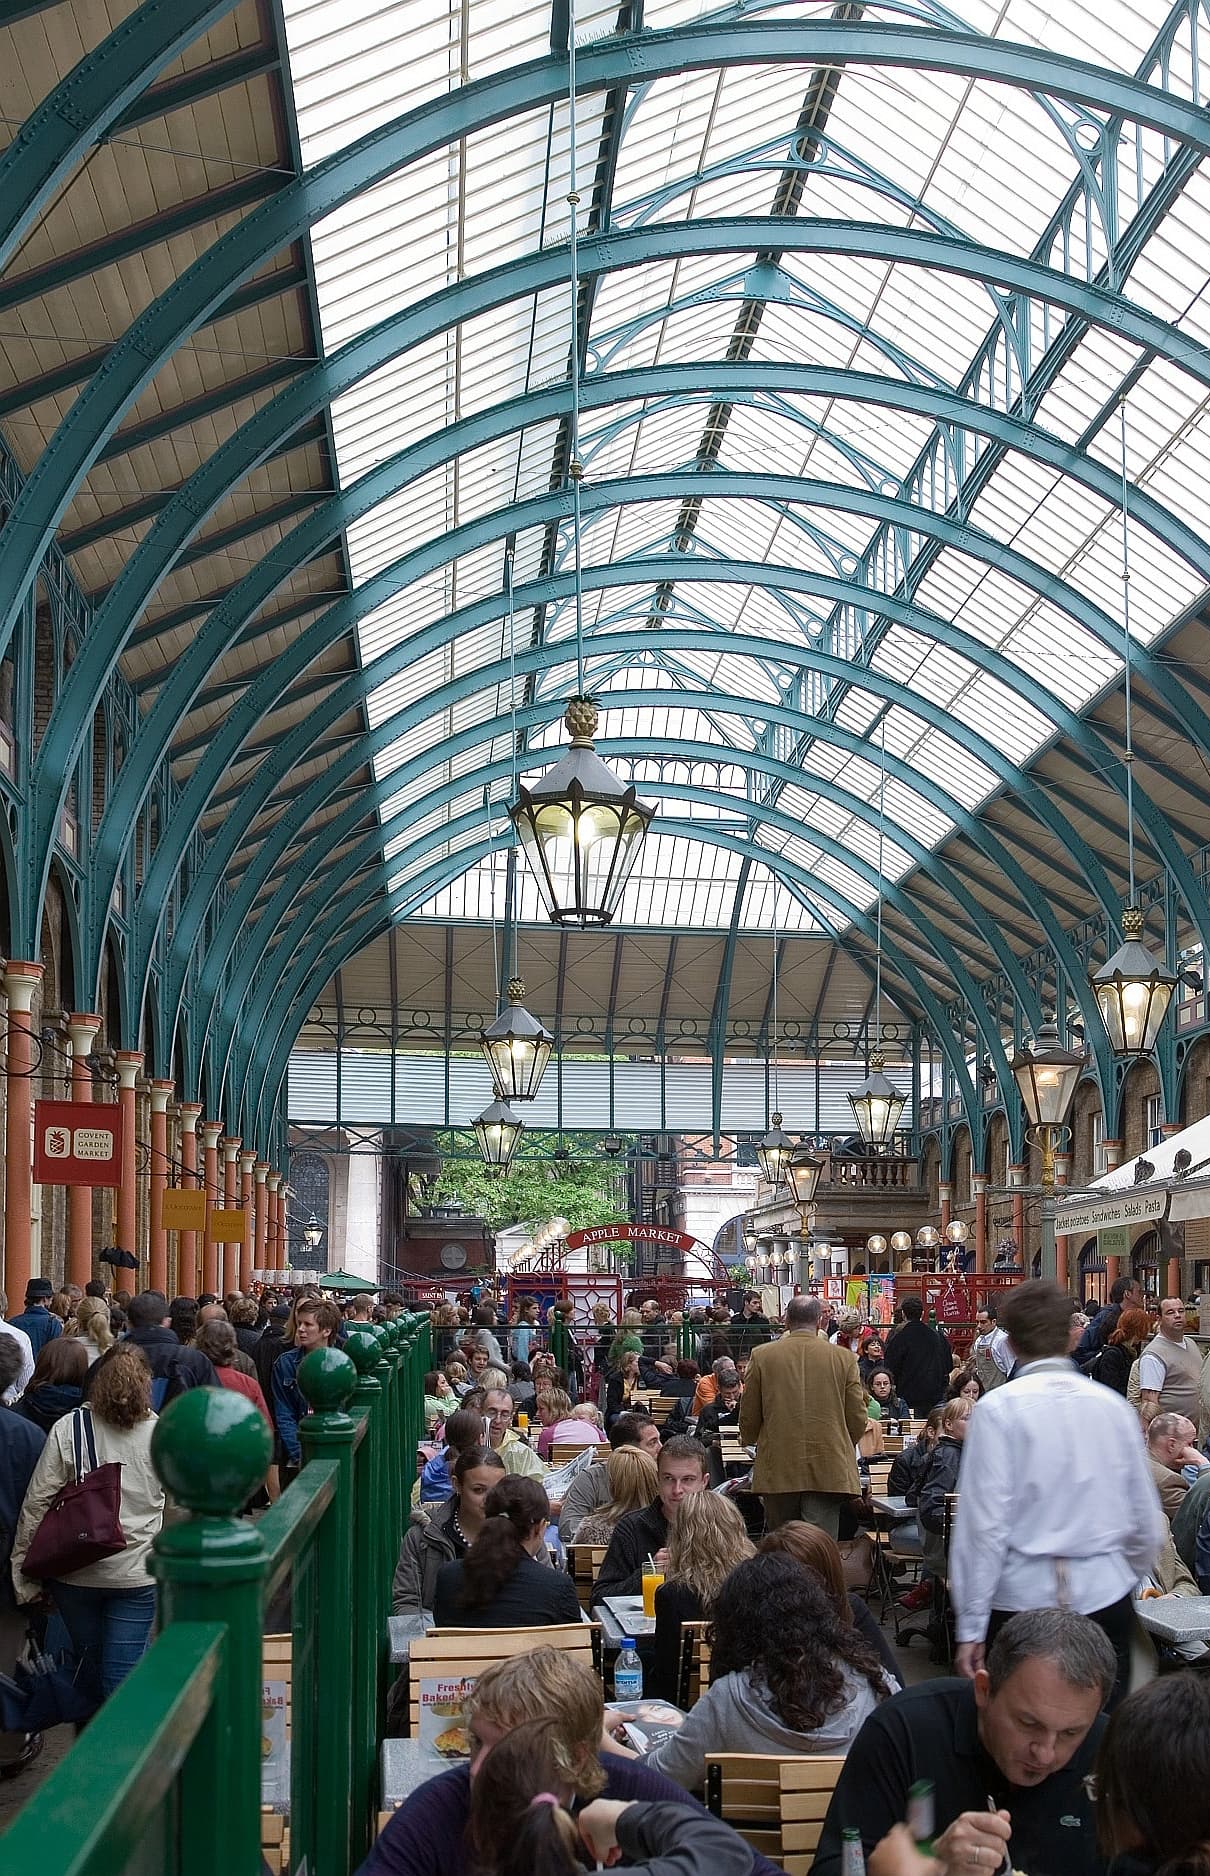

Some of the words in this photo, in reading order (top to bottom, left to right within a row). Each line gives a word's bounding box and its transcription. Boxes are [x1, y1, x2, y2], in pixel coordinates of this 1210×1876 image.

[78, 1132, 110, 1140] COVENT
[78, 1141, 110, 1149] GARDEN
[77, 1150, 110, 1158] MARKET
[1055, 1216, 1070, 1230] Jacket
[1070, 1213, 1089, 1229] potatoes
[1092, 1208, 1121, 1223] Sandwiches
[1124, 1202, 1142, 1218] Salads
[1144, 1200, 1160, 1213] Pasta
[582, 1228, 620, 1243] APPLE
[627, 1227, 683, 1245] MARKET
[422, 1693, 455, 1702] Baked
